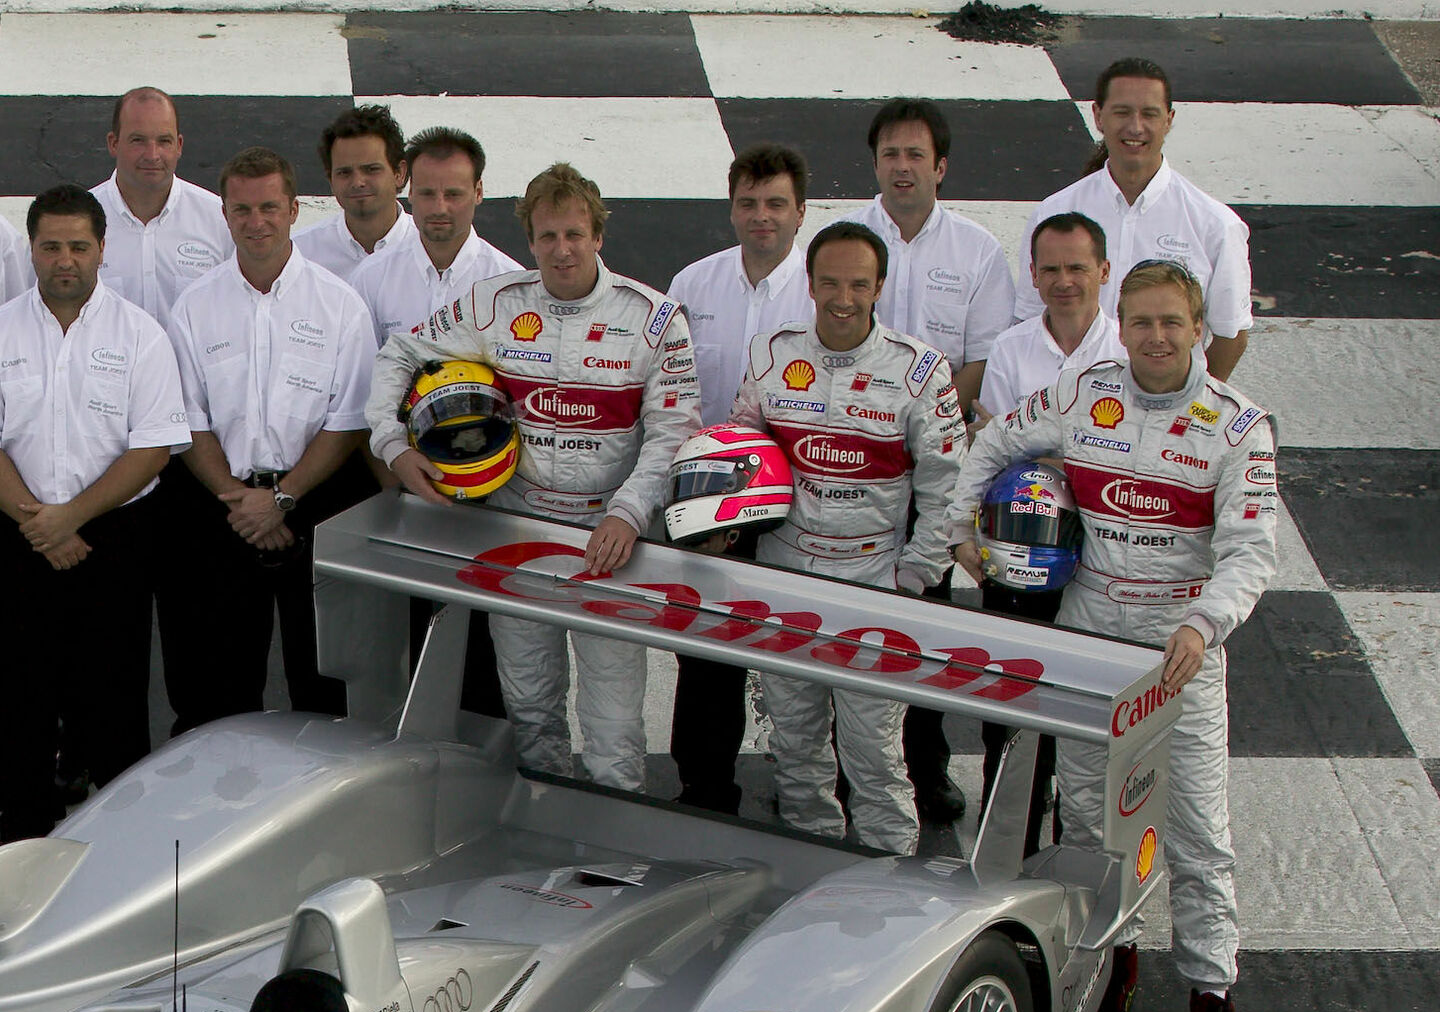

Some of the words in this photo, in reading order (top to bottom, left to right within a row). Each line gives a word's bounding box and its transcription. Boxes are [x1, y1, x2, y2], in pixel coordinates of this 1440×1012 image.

[650, 301, 674, 335] sparco
[206, 341, 231, 354] Canon
[505, 351, 550, 362] MICHELIN
[583, 356, 632, 370] Canon
[912, 350, 938, 384] sparco
[427, 387, 451, 401] TEAM
[452, 384, 481, 393] JOEST
[1092, 380, 1122, 390] REMUS
[537, 387, 596, 418] Infineon
[779, 400, 825, 412] MICHELIN
[846, 405, 896, 423] Canon
[521, 434, 555, 448] TEAM
[558, 440, 602, 451] JOEST
[806, 435, 865, 464] Infineon
[1084, 436, 1131, 452] MICHELIN
[1161, 449, 1209, 470] Canon
[798, 478, 822, 499] TEAM
[825, 489, 867, 500] JOEST
[1114, 479, 1170, 512] Infineon
[743, 507, 769, 519] Marco
[1010, 501, 1033, 514] Red
[1035, 503, 1058, 518] Bull
[1095, 527, 1129, 543] TEAM
[1132, 536, 1176, 546] JOEST
[1006, 567, 1048, 578] REMUS
[456, 541, 1046, 702] Canon
[1124, 768, 1155, 808] Infineon
